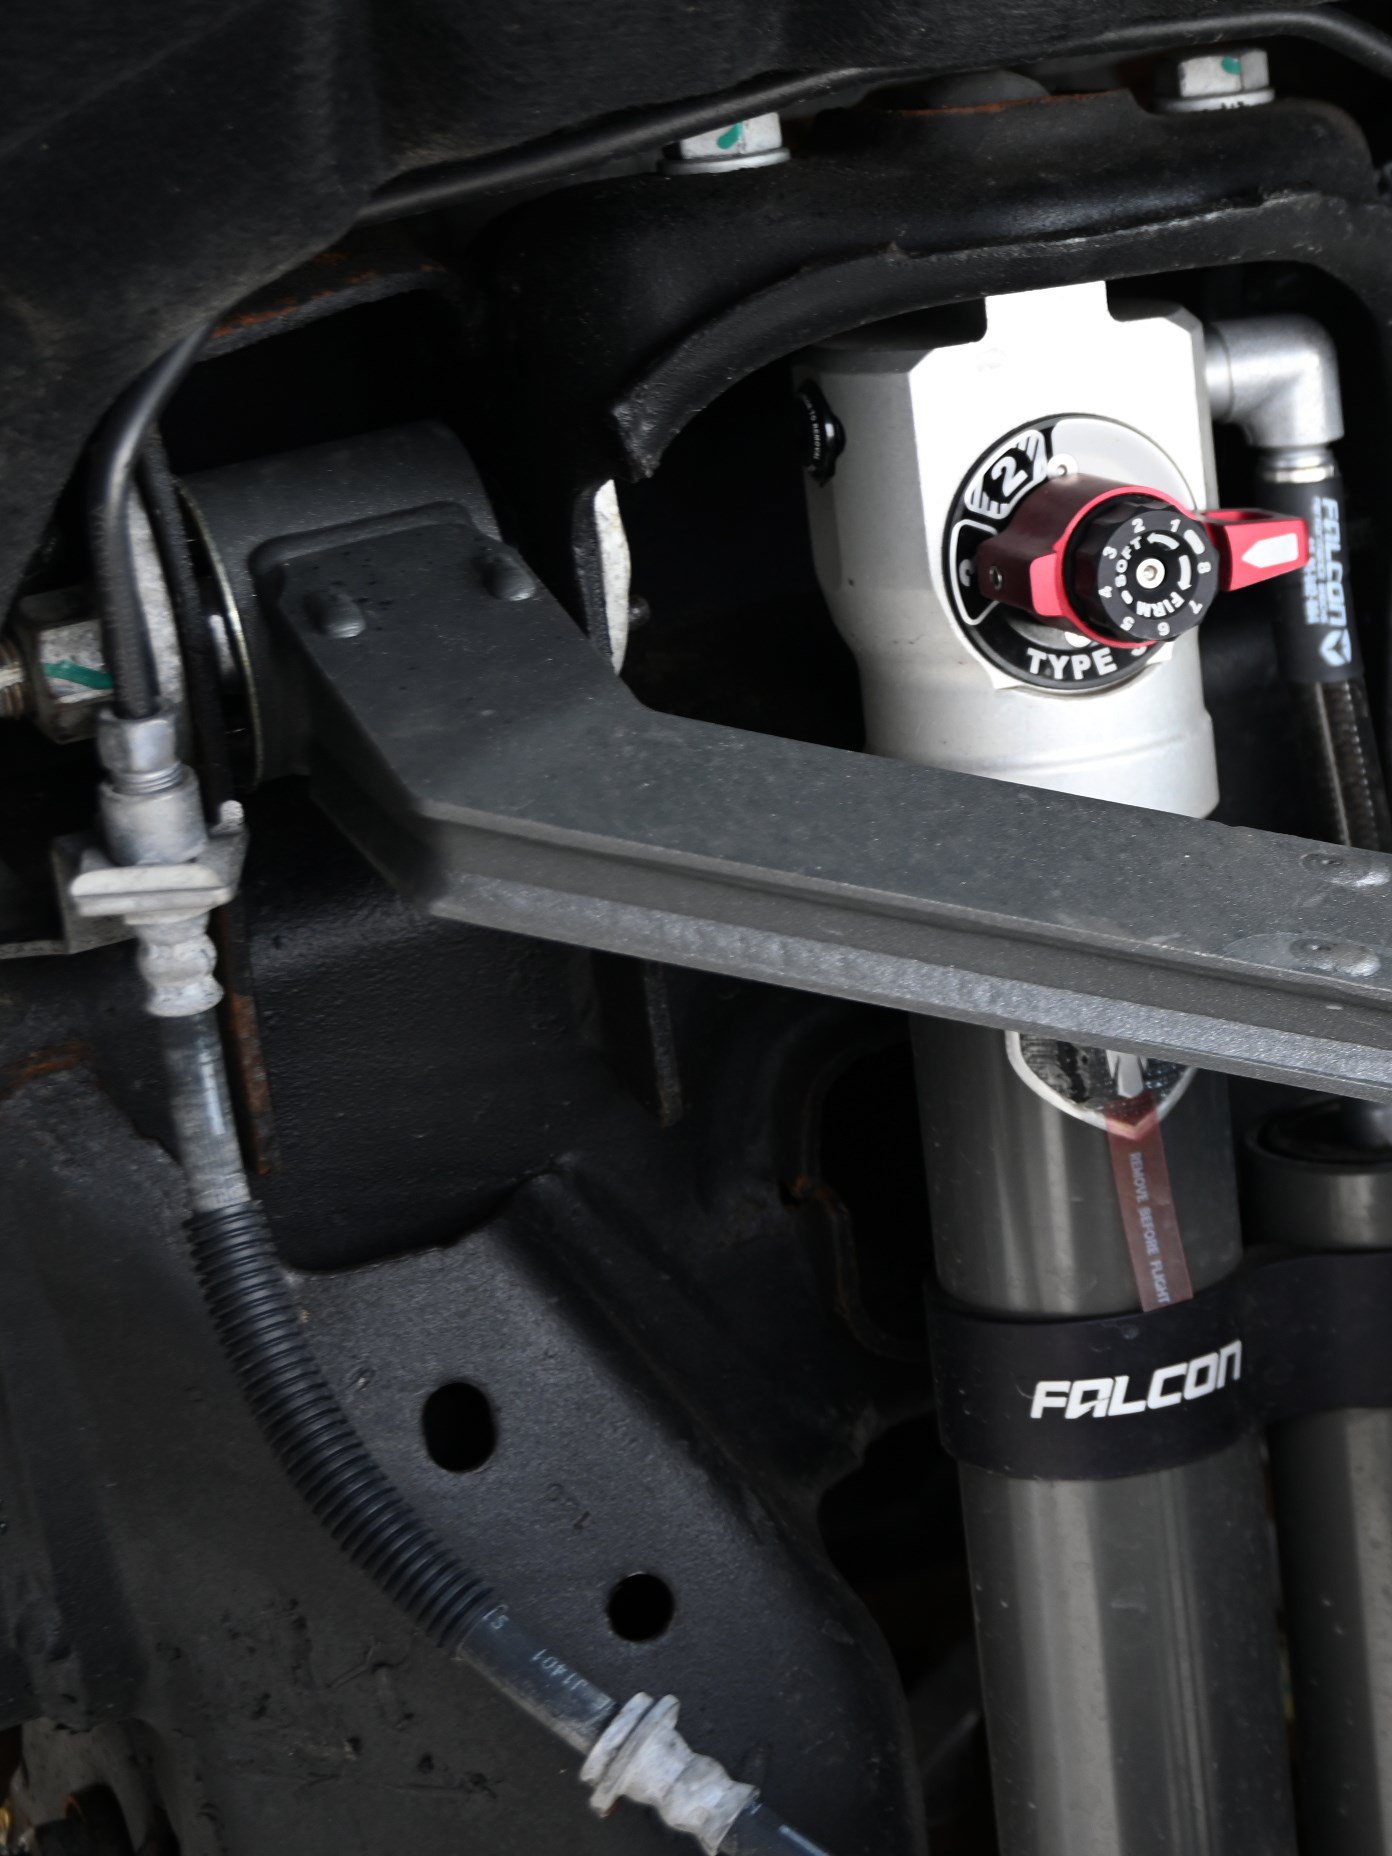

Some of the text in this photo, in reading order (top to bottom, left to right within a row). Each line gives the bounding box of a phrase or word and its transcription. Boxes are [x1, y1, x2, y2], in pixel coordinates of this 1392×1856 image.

[991, 456, 1028, 497] 2
[1131, 518, 1146, 533] 2
[1170, 519, 1181, 532] 1
[1102, 546, 1117, 559] 3
[1114, 535, 1142, 588] SOFT
[1197, 561, 1211, 574] 8
[1322, 497, 1347, 626] FALCON
[1098, 586, 1112, 598] 4
[1136, 591, 1185, 617] FIRM
[1188, 600, 1203, 614] 7
[1120, 616, 1135, 631] 5
[1157, 621, 1171, 636] 6
[1027, 647, 1118, 680] TYPE
[1129, 1151, 1171, 1304] REMOVE BEFORE FLIGHT
[1031, 1339, 1243, 1420] FALCON
